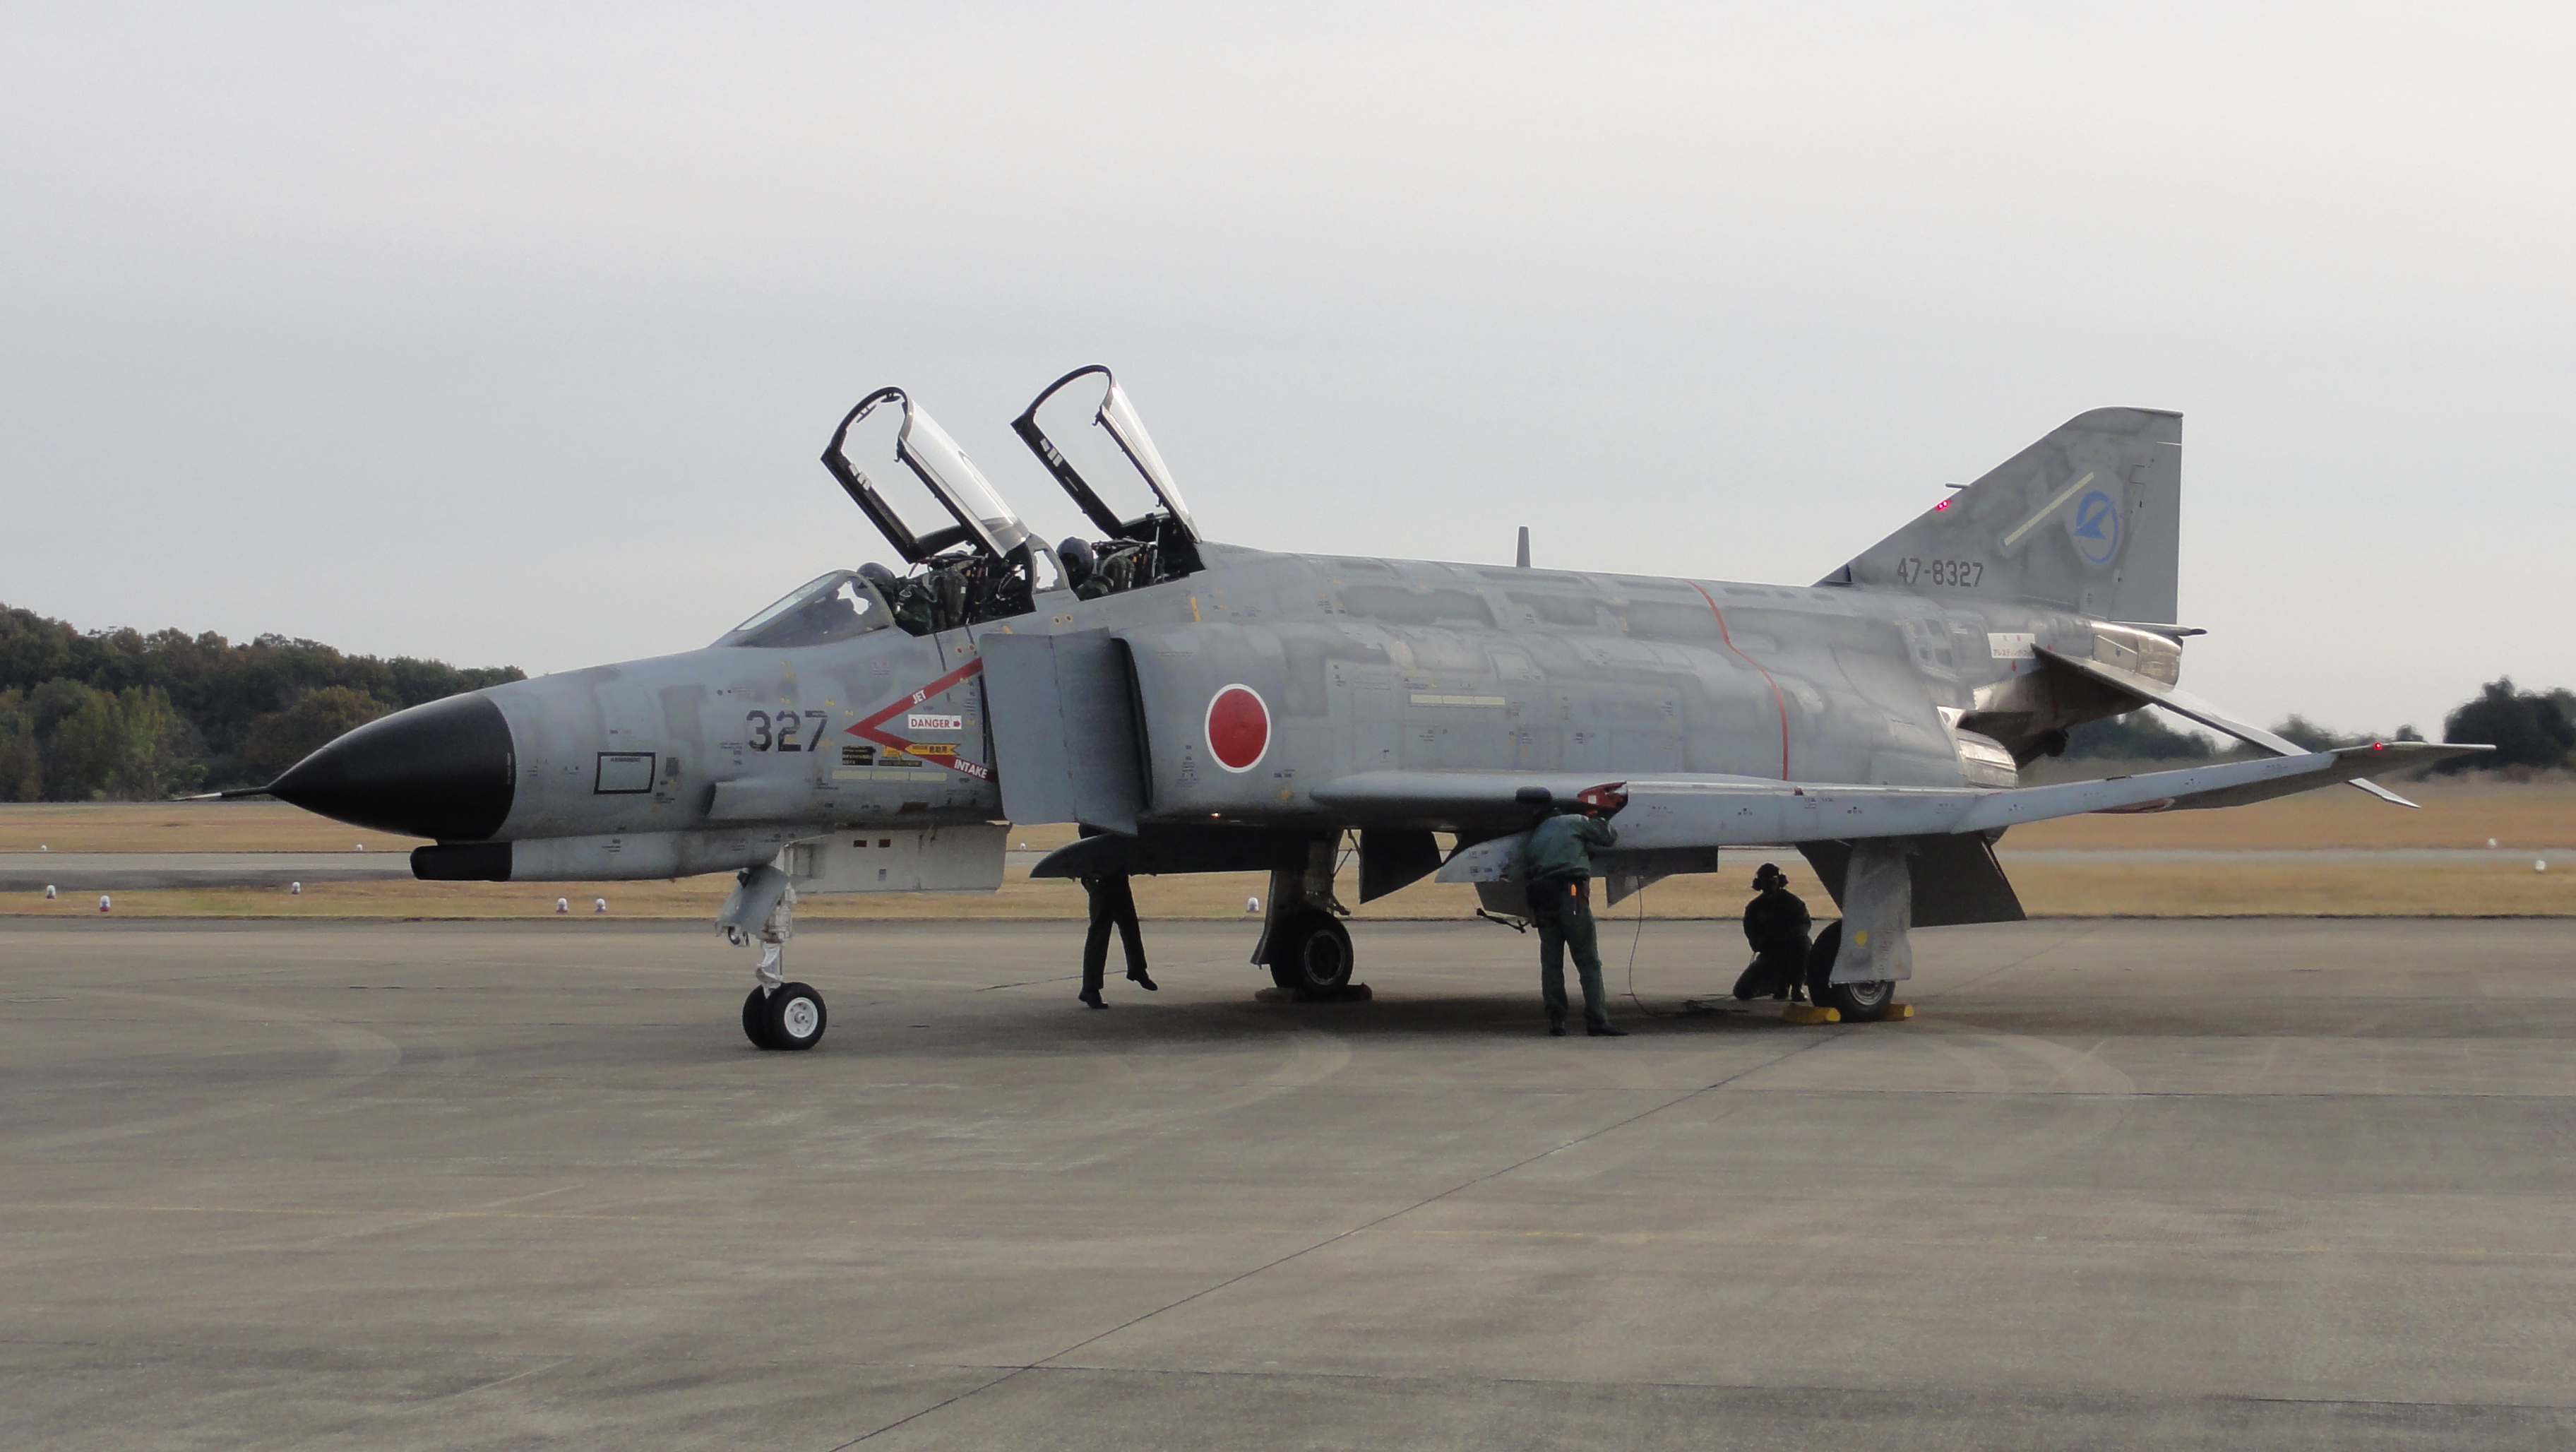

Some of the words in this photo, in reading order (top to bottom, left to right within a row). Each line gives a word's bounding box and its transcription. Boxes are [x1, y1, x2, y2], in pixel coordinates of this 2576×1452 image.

[1897, 557, 1984, 588] 47-8327
[912, 690, 926, 704] JET
[746, 710, 828, 752] 327
[911, 718, 950, 728] DANGER
[954, 758, 988, 779] INTAKE
